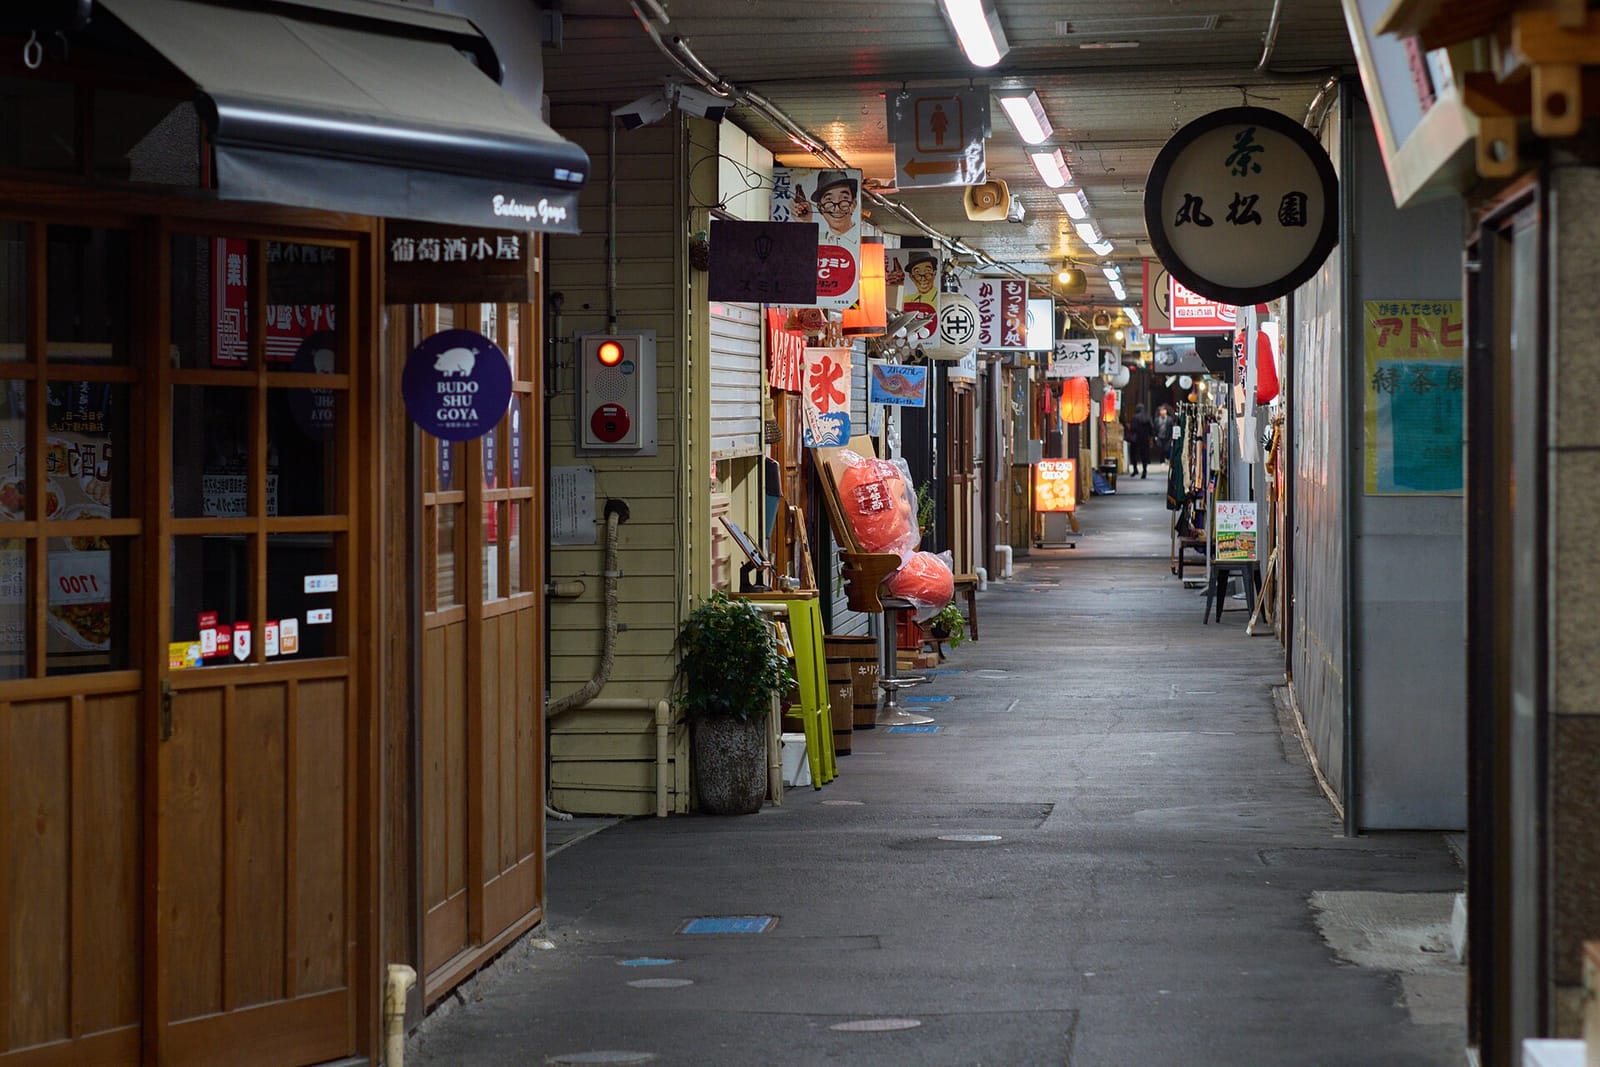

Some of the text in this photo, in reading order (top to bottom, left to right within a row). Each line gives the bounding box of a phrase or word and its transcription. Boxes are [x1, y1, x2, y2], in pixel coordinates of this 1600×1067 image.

[1225, 127, 1264, 177] 茶
[1174, 191, 1308, 227] 丸松園
[391, 236, 520, 263] 葡萄酒小屋
[817, 257, 850, 268] ナミン
[818, 268, 830, 279] C
[1378, 304, 1453, 316] がまんできない
[1052, 342, 1095, 362] 杉の子
[436, 381, 479, 394] BUDO
[809, 355, 846, 413] 氷
[443, 395, 472, 407] SHU
[436, 408, 479, 421] GOYA
